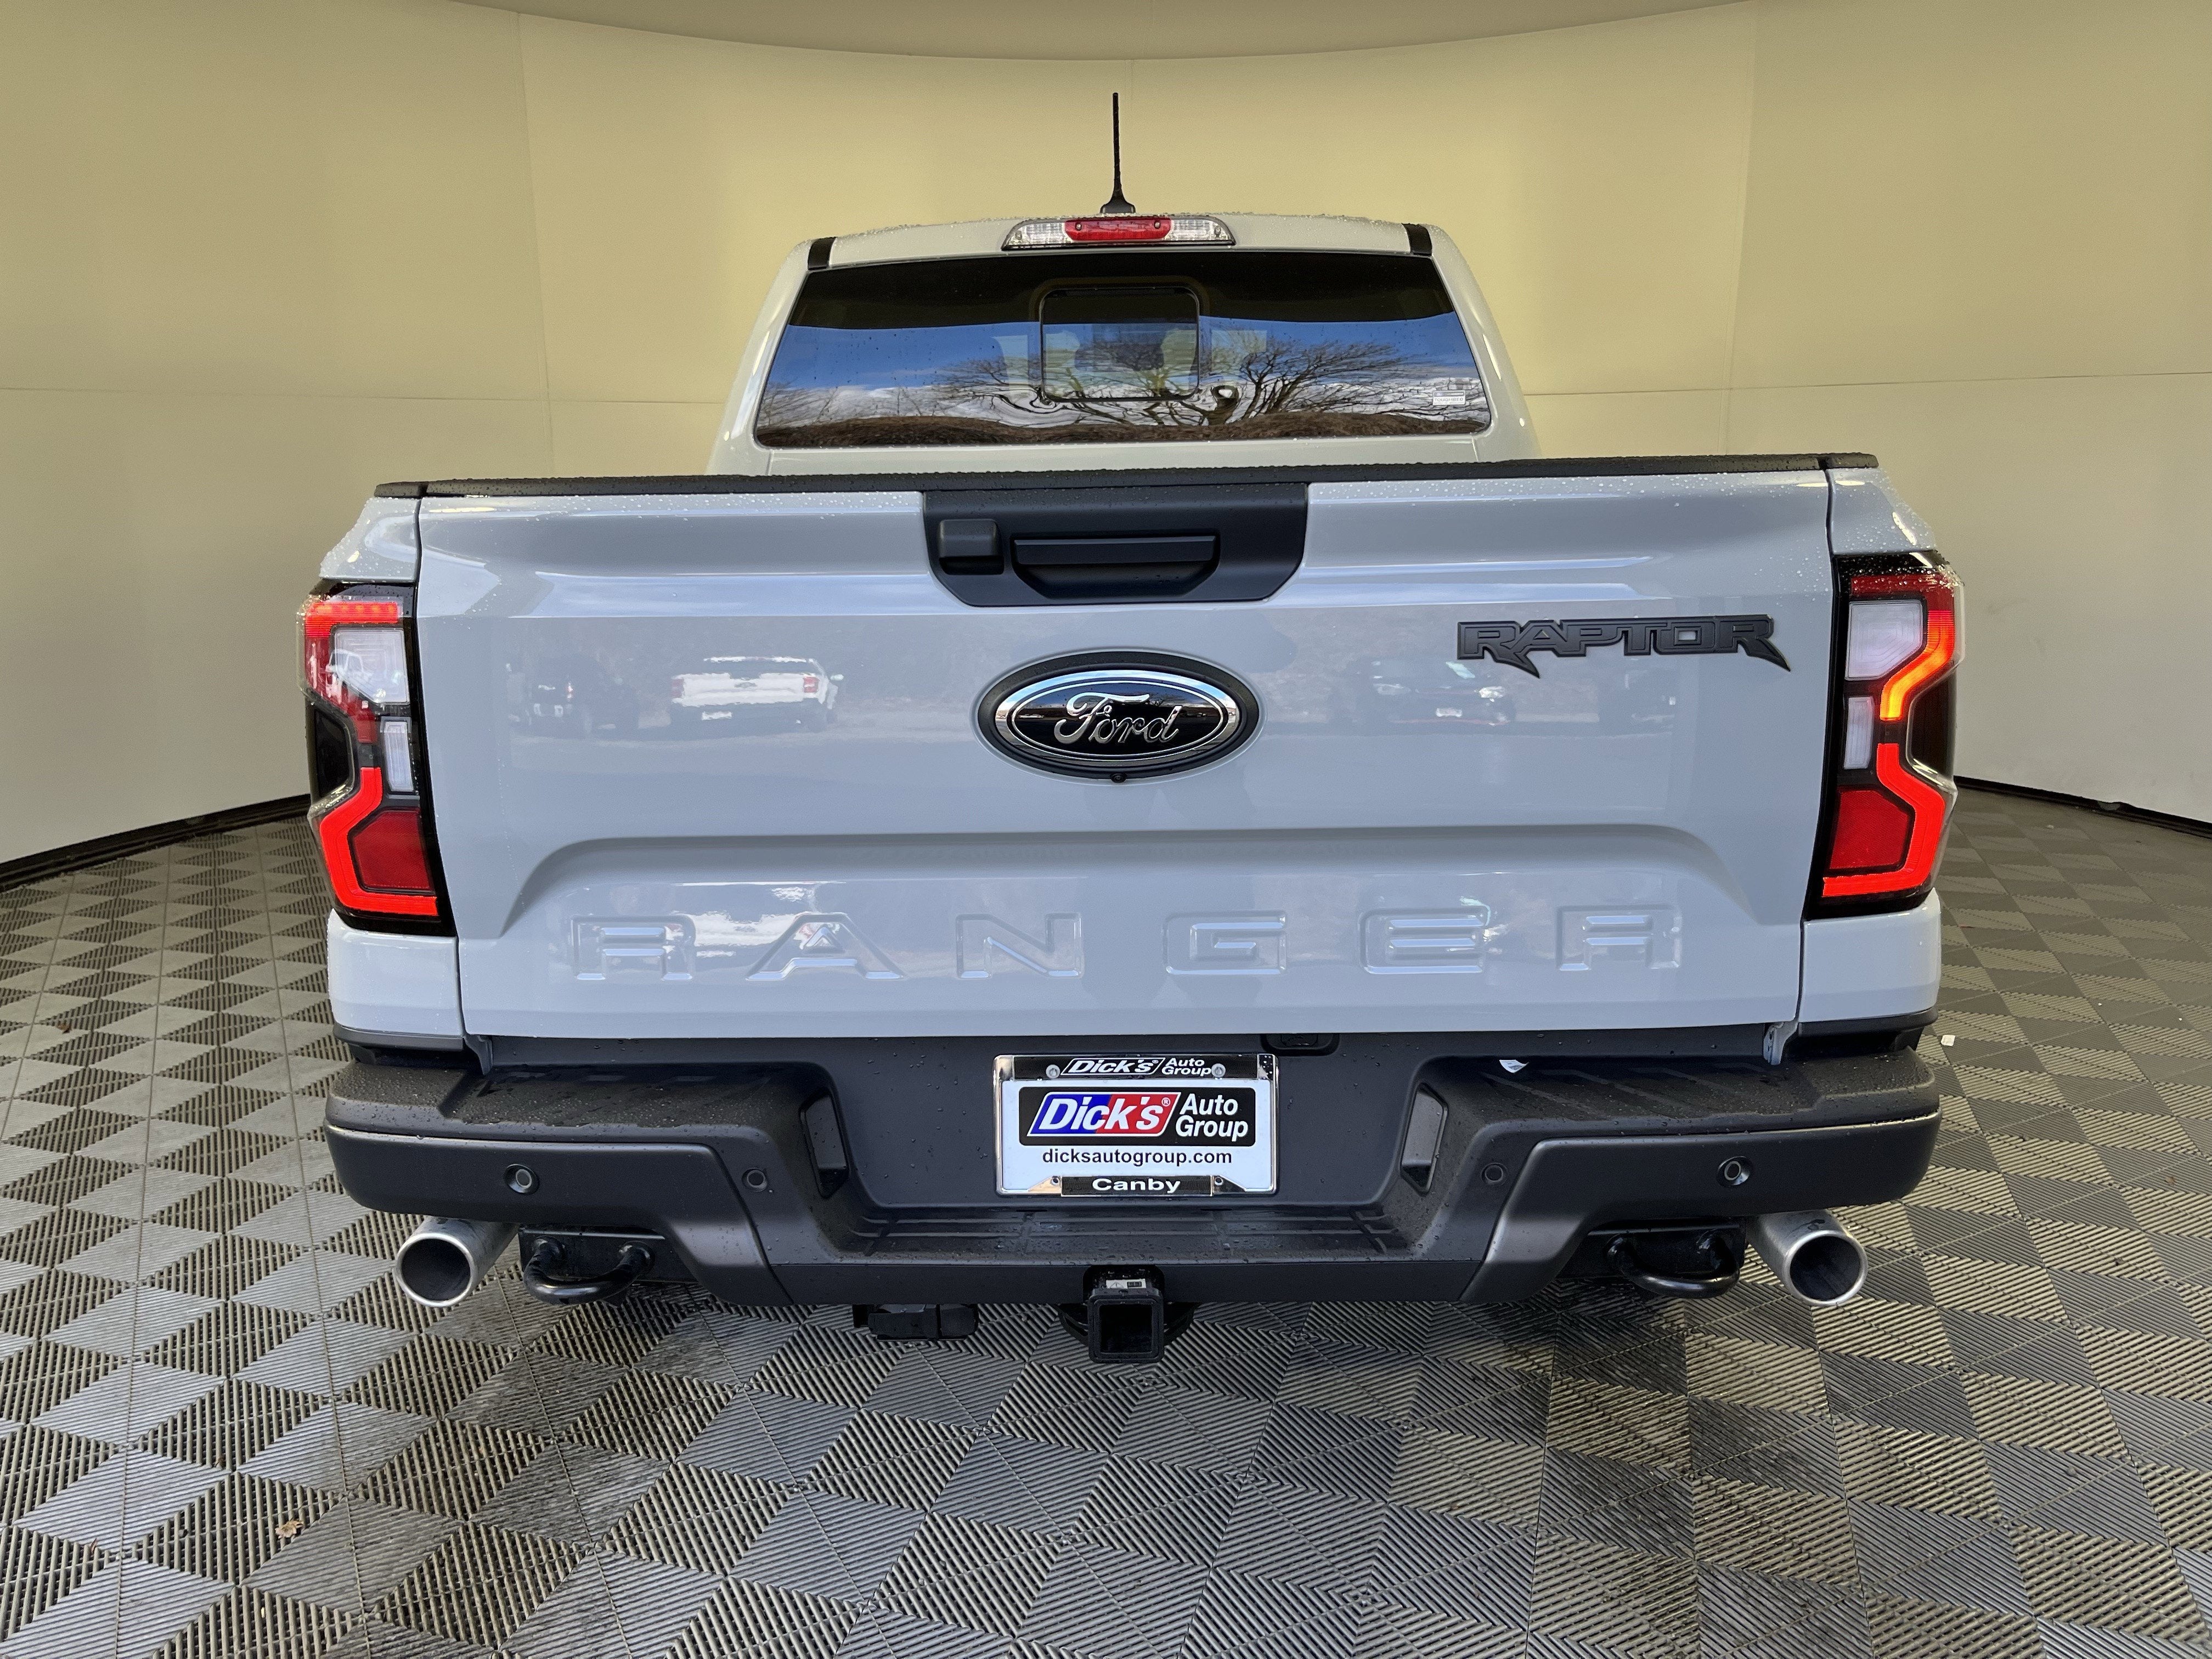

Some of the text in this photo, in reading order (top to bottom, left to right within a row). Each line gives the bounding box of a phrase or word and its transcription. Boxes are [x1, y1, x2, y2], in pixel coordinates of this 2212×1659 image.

[1457, 614, 1791, 679] RAPTOR
[1054, 691, 1182, 744] Ford
[571, 905, 1682, 981] RANGER
[1161, 1066, 1211, 1076] Group
[1165, 1058, 1205, 1066] Auto
[1180, 1093, 1239, 1115] Auto
[1176, 1115, 1248, 1141] Group
[1042, 1148, 1232, 1167] dicksautogroup.com
[1092, 1177, 1181, 1193] Canby
